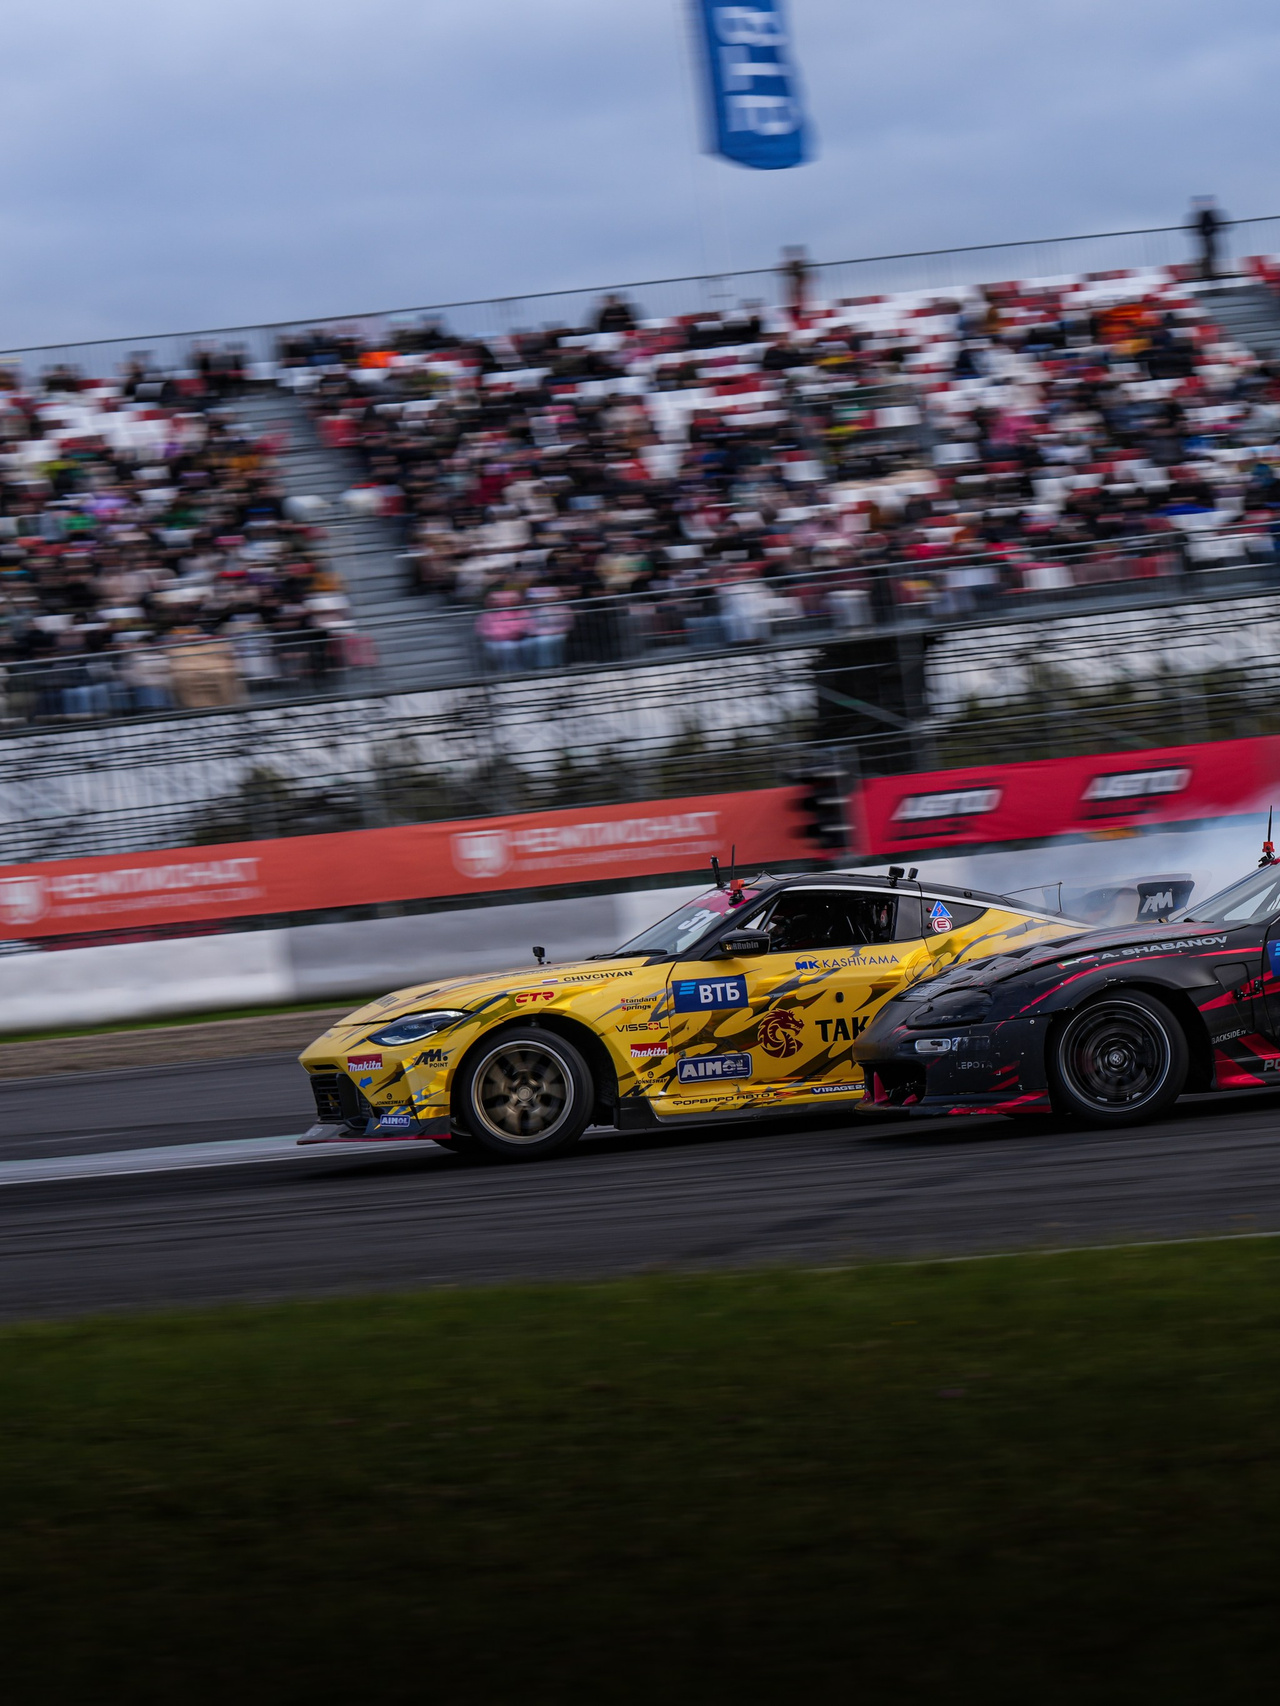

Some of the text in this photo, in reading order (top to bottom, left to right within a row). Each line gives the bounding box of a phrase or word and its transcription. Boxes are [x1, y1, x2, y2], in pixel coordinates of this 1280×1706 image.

[1101, 936, 1227, 960] A. SHABANOV
[794, 955, 899, 971] MK KASHIYAMA
[563, 970, 633, 982] CHIVCHYAN
[515, 991, 554, 1003] CTR
[699, 982, 740, 1004] ВТБ
[620, 996, 657, 1004] Standard
[621, 1003, 652, 1012] Springs
[615, 1021, 669, 1032] VISSOL
[630, 1047, 668, 1058] makita
[348, 1059, 383, 1072] makita
[681, 1060, 748, 1078] AIMOL
[381, 1116, 408, 1126] AIMOL
